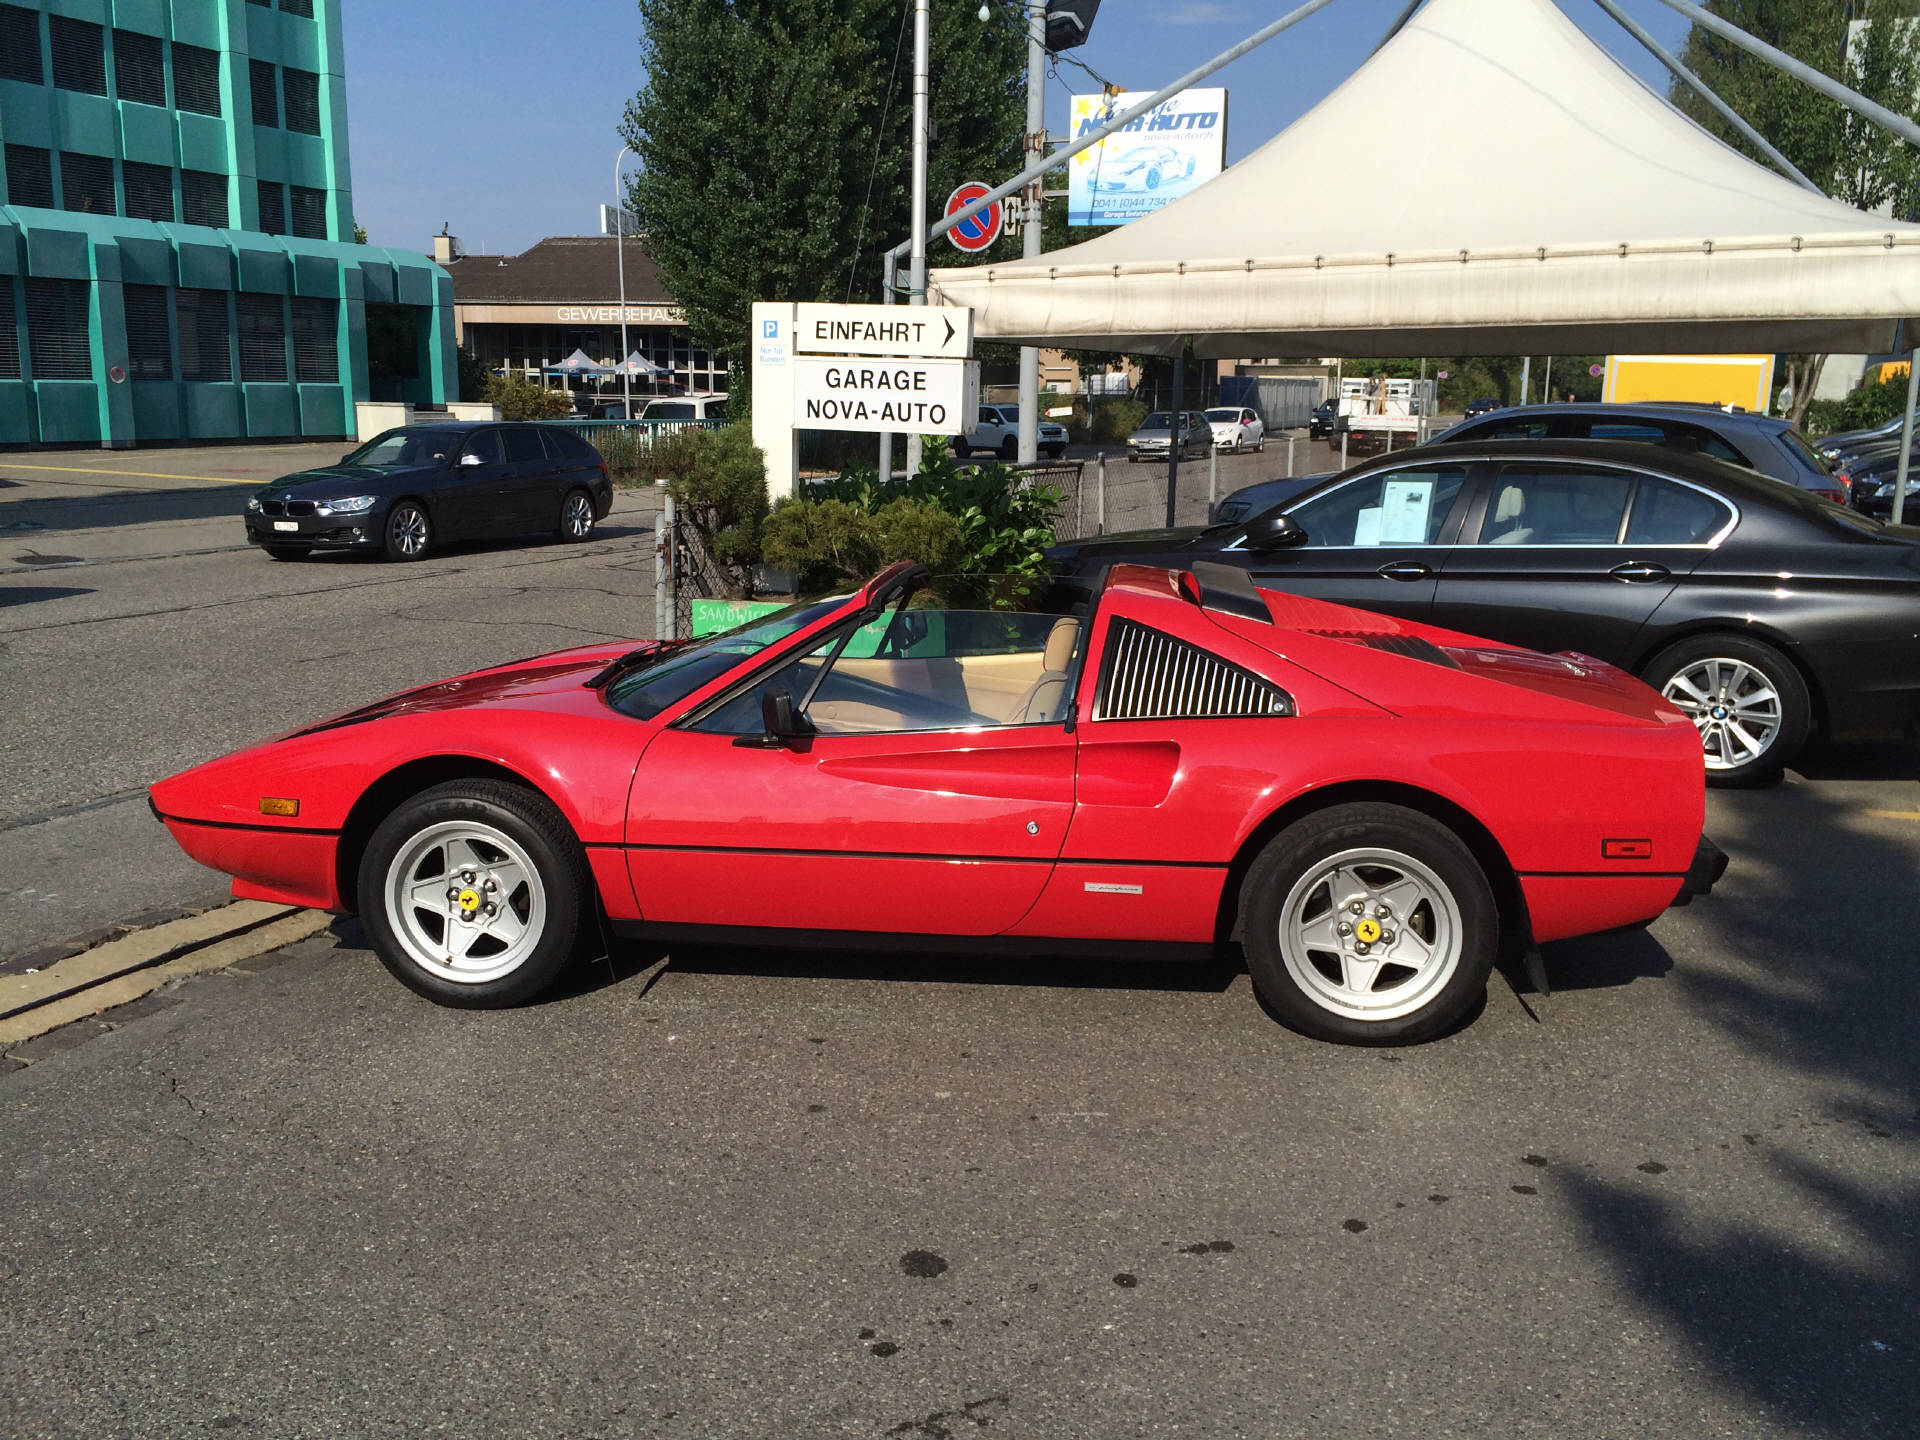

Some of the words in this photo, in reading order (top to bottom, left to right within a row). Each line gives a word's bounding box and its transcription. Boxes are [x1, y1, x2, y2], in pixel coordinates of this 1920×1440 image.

[765, 321, 777, 337] P
[815, 321, 926, 342] EINFAHRT
[825, 368, 927, 391] GARAGE
[807, 399, 946, 425] NOVA-AUTO
